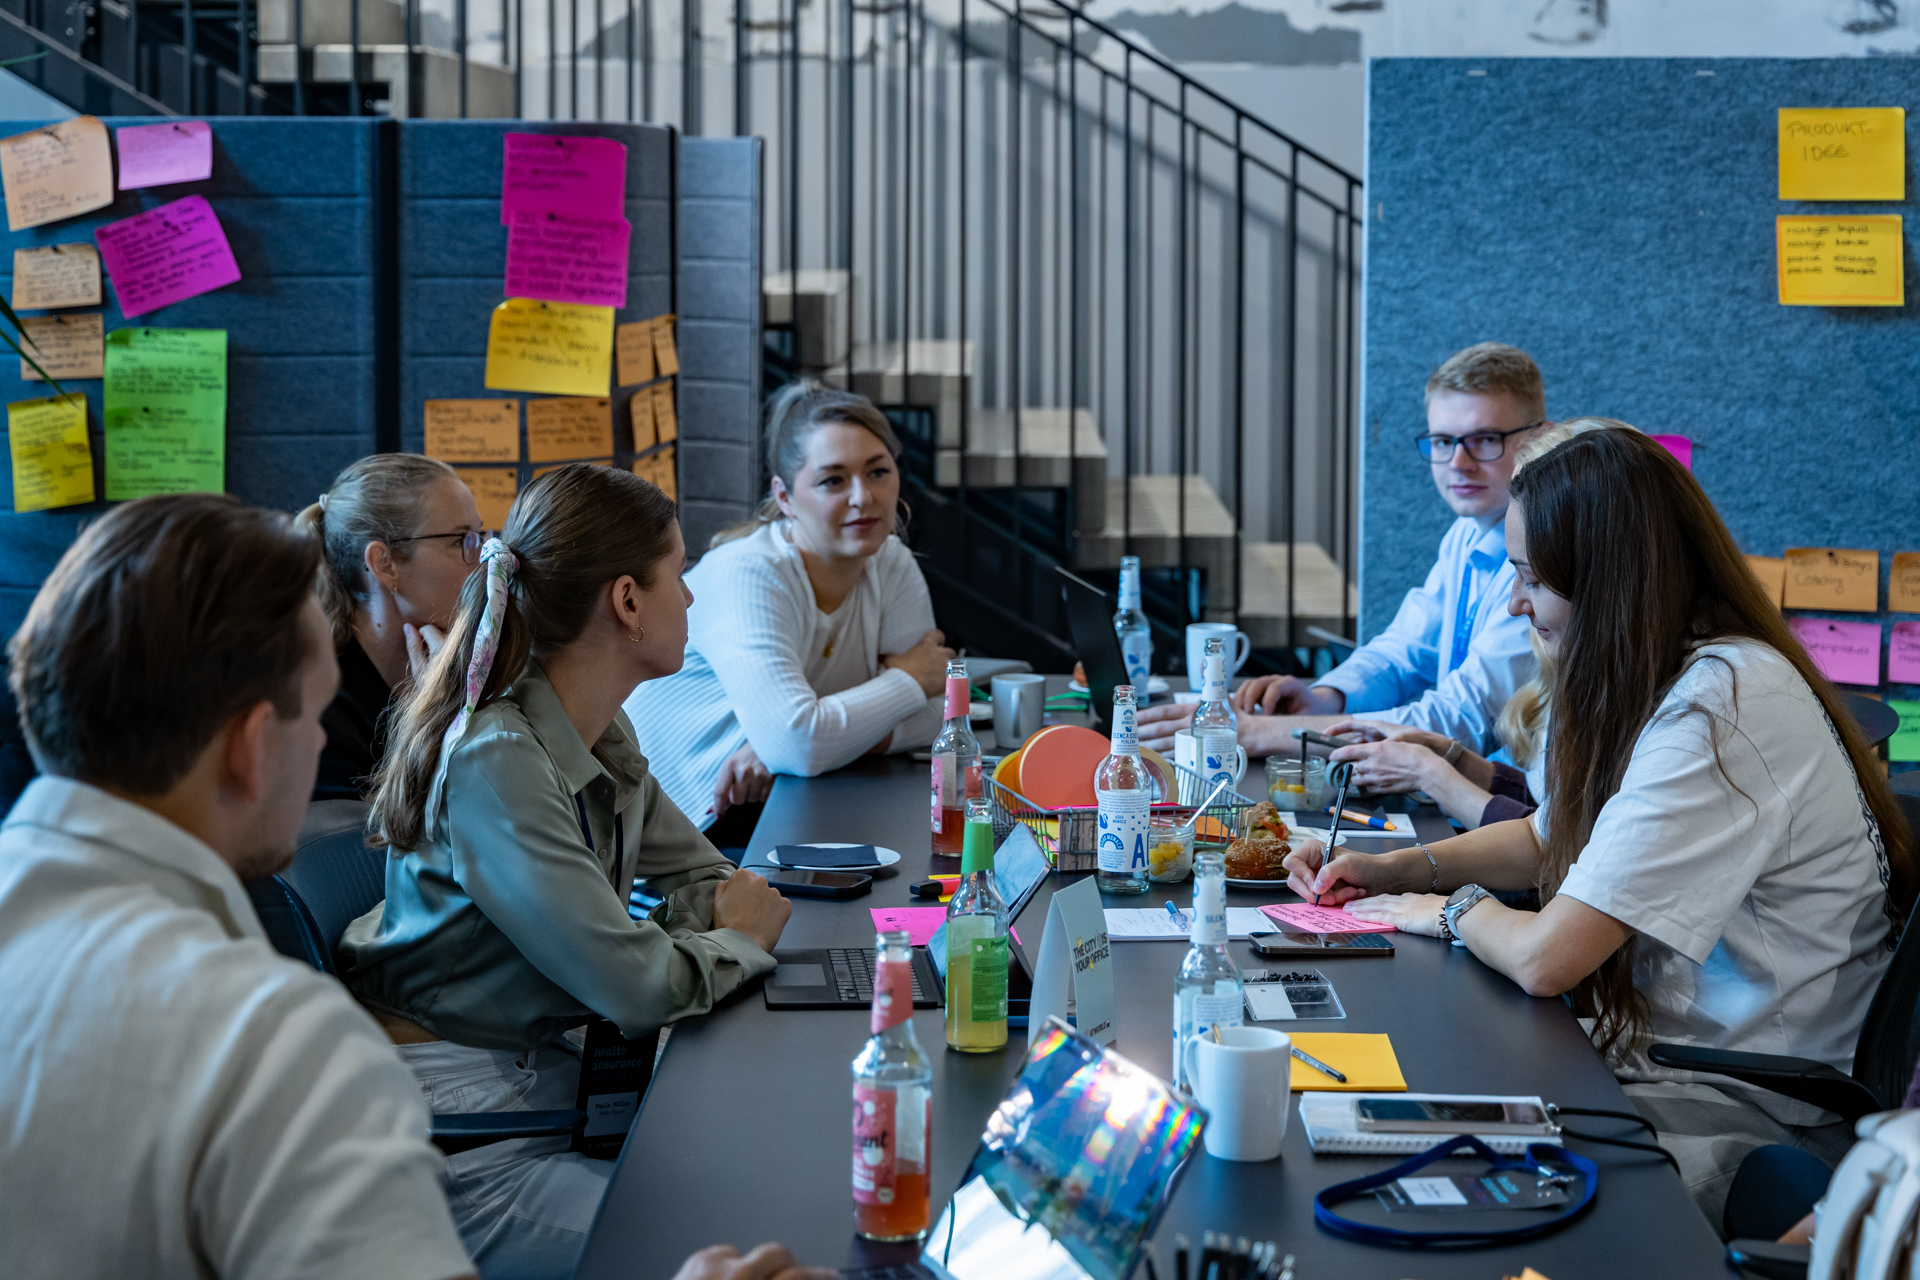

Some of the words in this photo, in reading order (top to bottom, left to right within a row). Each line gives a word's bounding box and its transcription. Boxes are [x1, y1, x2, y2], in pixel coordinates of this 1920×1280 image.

[1073, 944, 1085, 960] THE
[1085, 938, 1097, 954] CITY
[1101, 932, 1107, 945] IS
[1075, 956, 1090, 973] YOUR
[1090, 945, 1109, 964] OFFICE
[594, 1045, 628, 1058] health
[592, 1058, 643, 1071] insurance
